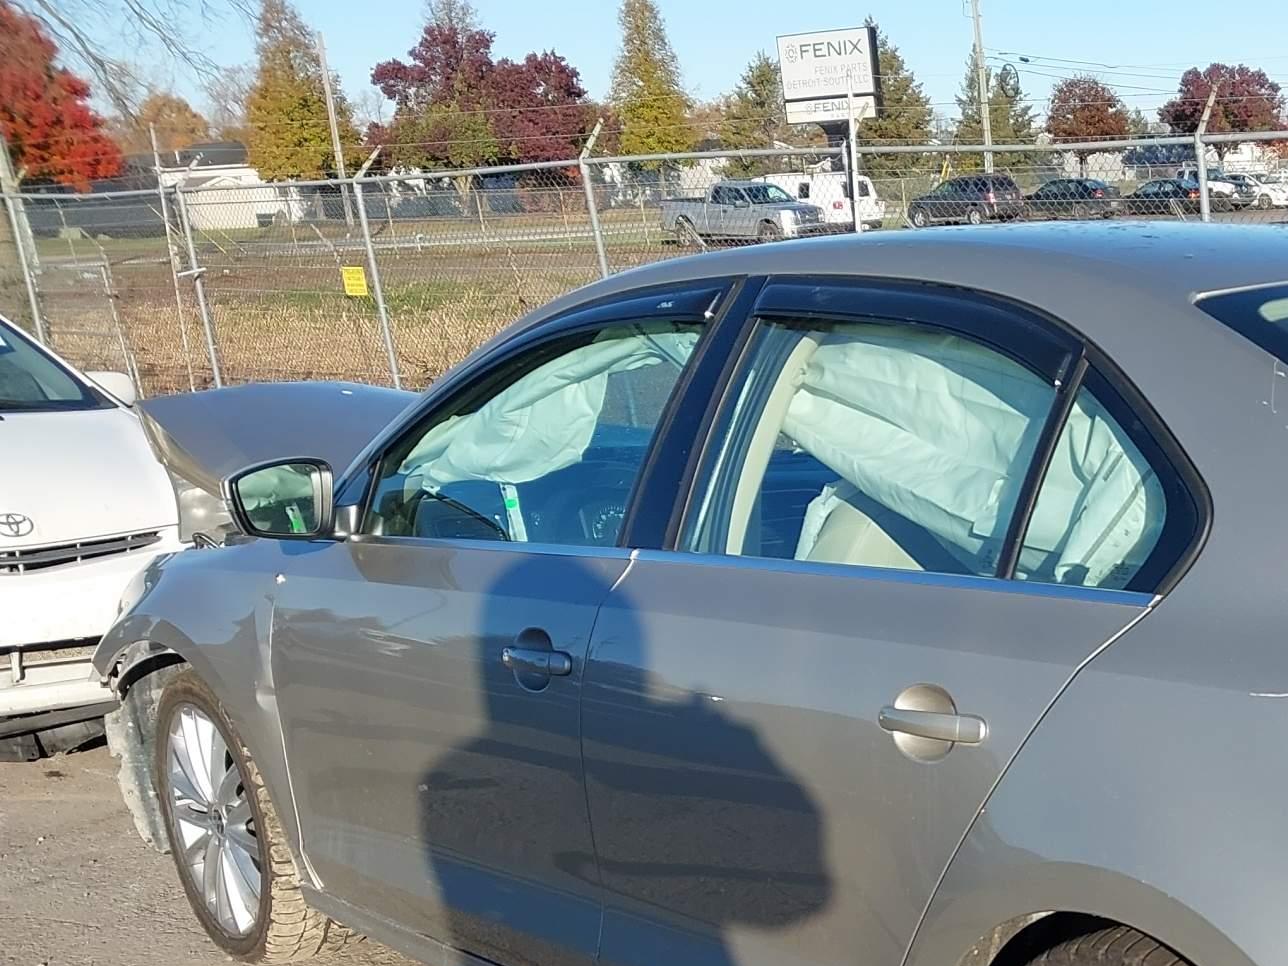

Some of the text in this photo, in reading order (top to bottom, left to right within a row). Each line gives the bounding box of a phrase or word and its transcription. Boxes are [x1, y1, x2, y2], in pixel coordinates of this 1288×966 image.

[800, 39, 863, 59] FENIX
[815, 62, 868, 75] FENIX PARTS
[786, 78, 820, 89] DETROIT
[854, 74, 869, 84] LLC
